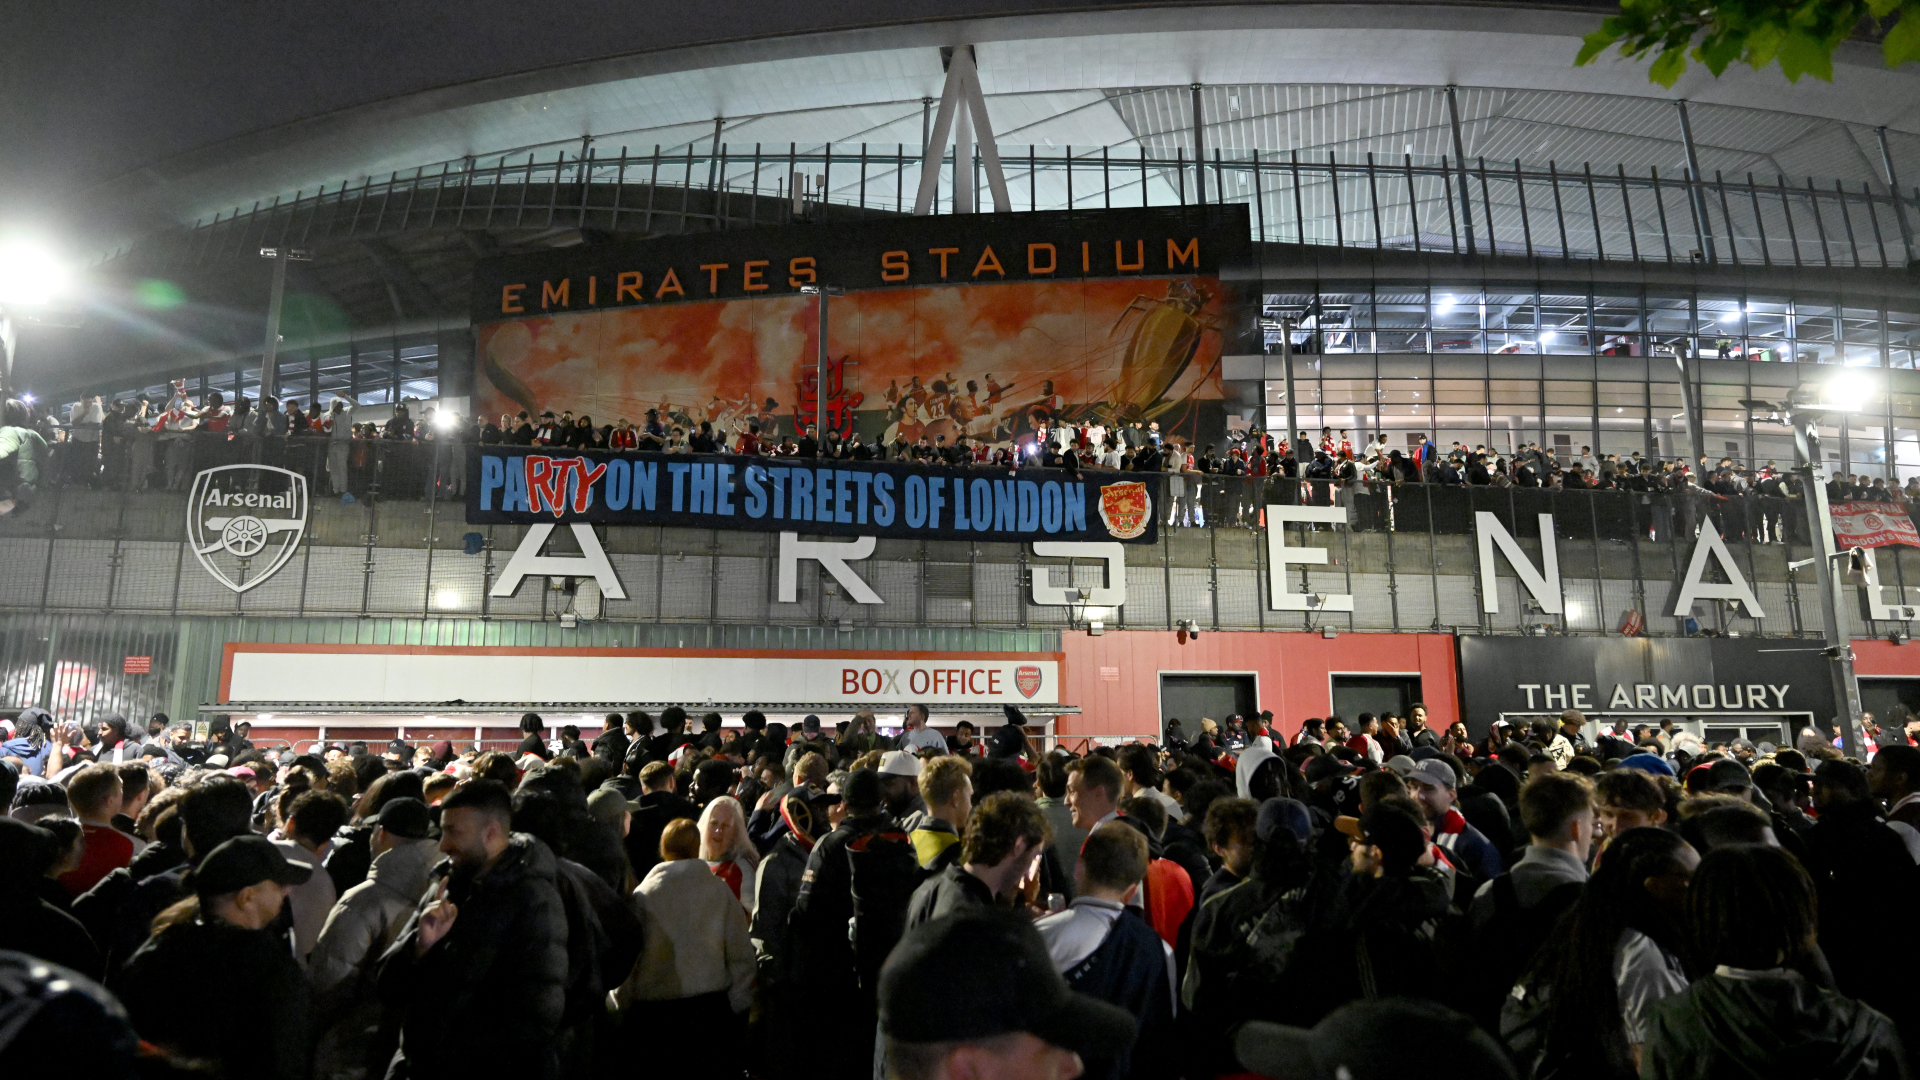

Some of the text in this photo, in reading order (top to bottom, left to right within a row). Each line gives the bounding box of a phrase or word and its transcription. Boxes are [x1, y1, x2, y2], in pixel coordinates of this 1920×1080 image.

[502, 237, 1199, 313] EMIRATES STADIUM
[930, 402, 945, 419] 23
[205, 488, 292, 509] Arsenal
[480, 455, 1087, 533] PARTY ON THE STREETS OF LONDON
[1103, 485, 1144, 498] Arsenal
[1851, 502, 1905, 514] ARSENAL
[1841, 532, 1895, 546] LONDON'S
[842, 668, 1003, 695] BOX OFFICE
[1018, 669, 1040, 677] Arsenal
[1518, 683, 1790, 709] THE ARMOURY
